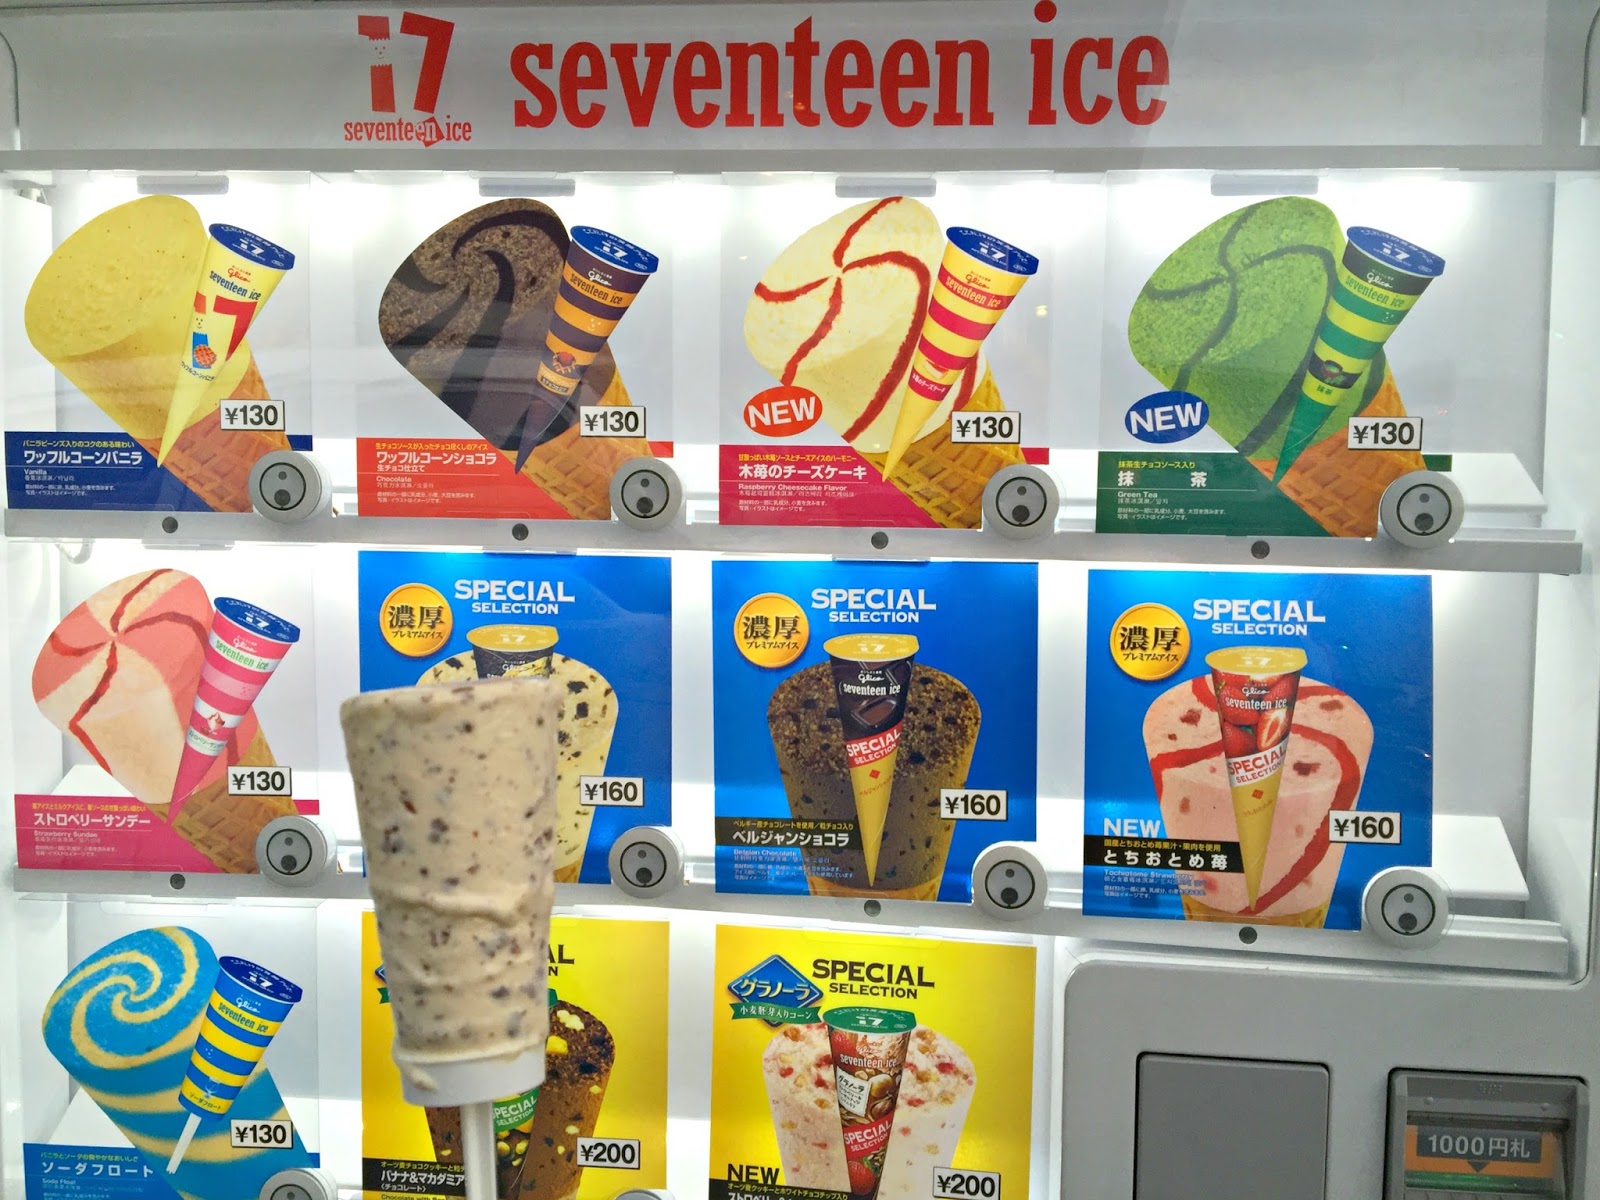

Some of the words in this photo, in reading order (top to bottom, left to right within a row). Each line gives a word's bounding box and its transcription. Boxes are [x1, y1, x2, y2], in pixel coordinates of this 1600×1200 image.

[509, 16, 995, 129] seventeen
[1028, 1, 1170, 128] ice
[343, 117, 438, 142] seventeen
[445, 114, 472, 141] ice
[209, 270, 248, 297] seventeen
[249, 288, 261, 300] ice
[570, 273, 609, 301] seventeen
[610, 292, 623, 304] ice
[945, 275, 987, 304] seventeen
[987, 295, 1001, 308] ice
[1346, 275, 1389, 304] seventeen
[1390, 295, 1405, 307] ice
[225, 405, 278, 426] ¥130
[584, 411, 638, 433] ¥130
[747, 396, 816, 429] NEW
[1129, 401, 1202, 435] NEW
[956, 416, 1013, 438] ¥130
[1353, 423, 1414, 445] ¥130
[24, 450, 142, 465] ワッフルコーンバニラ
[376, 451, 497, 465] ワッフルコーンショコラ
[1118, 461, 1195, 469] 抹茶生チョコソース入り
[739, 464, 867, 480] 木苺のチーズケーキ
[454, 579, 575, 603] SPECIAL
[811, 588, 936, 611] SPECIAL
[388, 605, 445, 630] 濃厚
[471, 602, 559, 615] SELECTION
[829, 611, 919, 623] SELECTION
[1192, 598, 1326, 623] SPECIAL
[391, 630, 443, 640] プレミアムアイス
[743, 615, 800, 640] 濃厚
[1211, 623, 1308, 636] SELECTION
[746, 640, 799, 650] プレミアムアイス
[1119, 626, 1181, 652] 濃厚
[215, 639, 255, 667] seventeen
[256, 658, 269, 670] ice
[1122, 652, 1180, 663] プレミアムアイス
[843, 683, 886, 696] seventeen
[889, 682, 901, 695] ice
[858, 673, 884, 683] Glico
[1225, 697, 1272, 710] seventeen
[1275, 696, 1287, 709] ice
[1242, 687, 1270, 697] Glico
[846, 729, 900, 757] SPECIAL
[854, 742, 897, 765] SELECTION
[1227, 746, 1286, 775] SPECIAL
[232, 771, 286, 791] ¥130
[1236, 761, 1281, 783] SELECTION
[584, 781, 638, 802] ¥160
[945, 794, 1001, 816] ¥160
[34, 813, 150, 827] ストロベリーサンデー
[1103, 818, 1161, 838] NEW
[1334, 817, 1394, 839] ¥160
[732, 831, 850, 847] ベルジャンショコラ
[1104, 850, 1228, 870] とちおとめ苺
[1104, 869, 1148, 877] Tochiotome
[812, 959, 935, 988] SPECIAL
[740, 978, 811, 1000] グラノーラ
[829, 983, 918, 999] SELECTION
[218, 1002, 255, 1030] seventeen
[256, 1021, 269, 1033] ice
[740, 1005, 812, 1020] 小麦胚芽入りコーン
[840, 1054, 882, 1068] seventeen
[885, 1058, 897, 1068] ice
[496, 1108, 533, 1126] SELECTION
[235, 1124, 287, 1144] ¥130
[843, 1121, 891, 1144] SPECIAL
[851, 1132, 888, 1152] SELECTION
[580, 1143, 636, 1164] ¥200
[1428, 1134, 1530, 1158] 1000円札
[42, 1162, 153, 1178] ソーダフロート
[727, 1163, 780, 1185] NEW
[937, 1174, 995, 1196] ¥200
